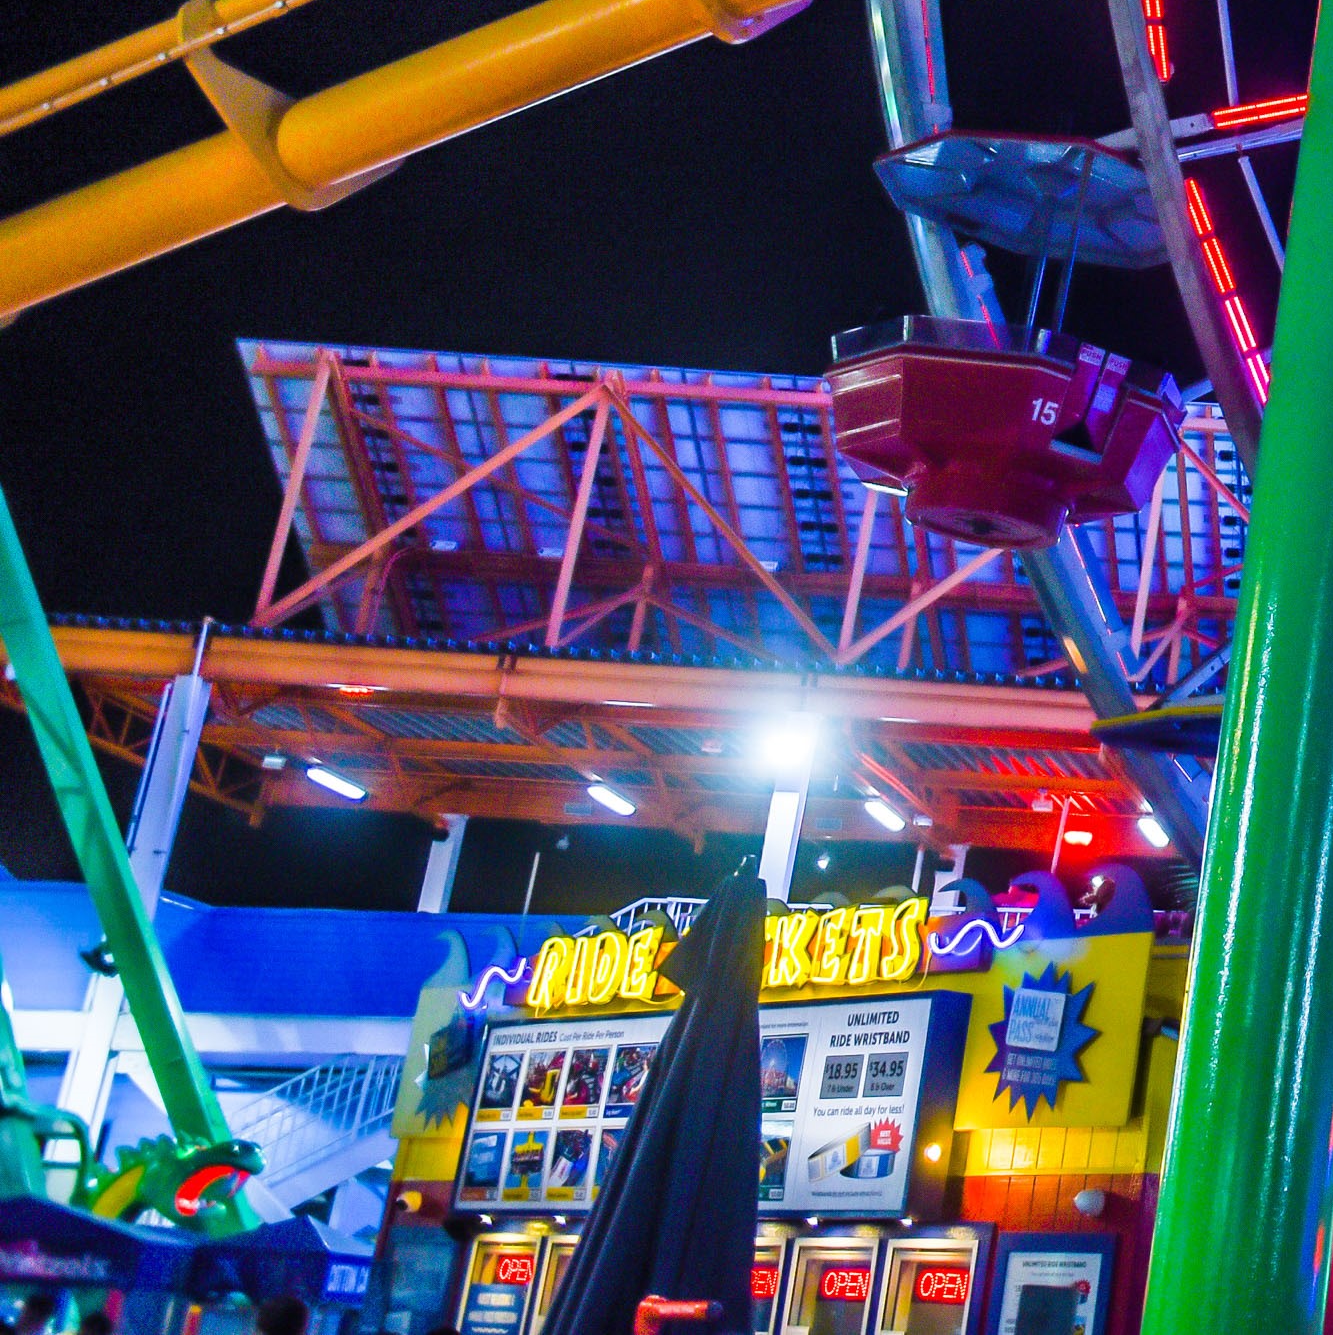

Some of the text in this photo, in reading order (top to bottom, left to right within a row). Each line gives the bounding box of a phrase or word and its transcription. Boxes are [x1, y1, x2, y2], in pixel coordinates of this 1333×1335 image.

[1031, 397, 1059, 426] 15
[528, 898, 926, 1006] RIDE KETS
[847, 1011, 900, 1026] UNLIMITED
[493, 1032, 534, 1045] INDIVIDUAL
[536, 1031, 558, 1043] RIDES
[605, 1029, 625, 1039] Person
[829, 1031, 910, 1047] RIDE WRISTBAND
[825, 1063, 858, 1080] $18.95
[869, 1060, 904, 1078] $34.95
[813, 1104, 905, 1117] You can ride all day for less!
[824, 1271, 870, 1297] OPEN
[920, 1272, 969, 1300] OPEN
